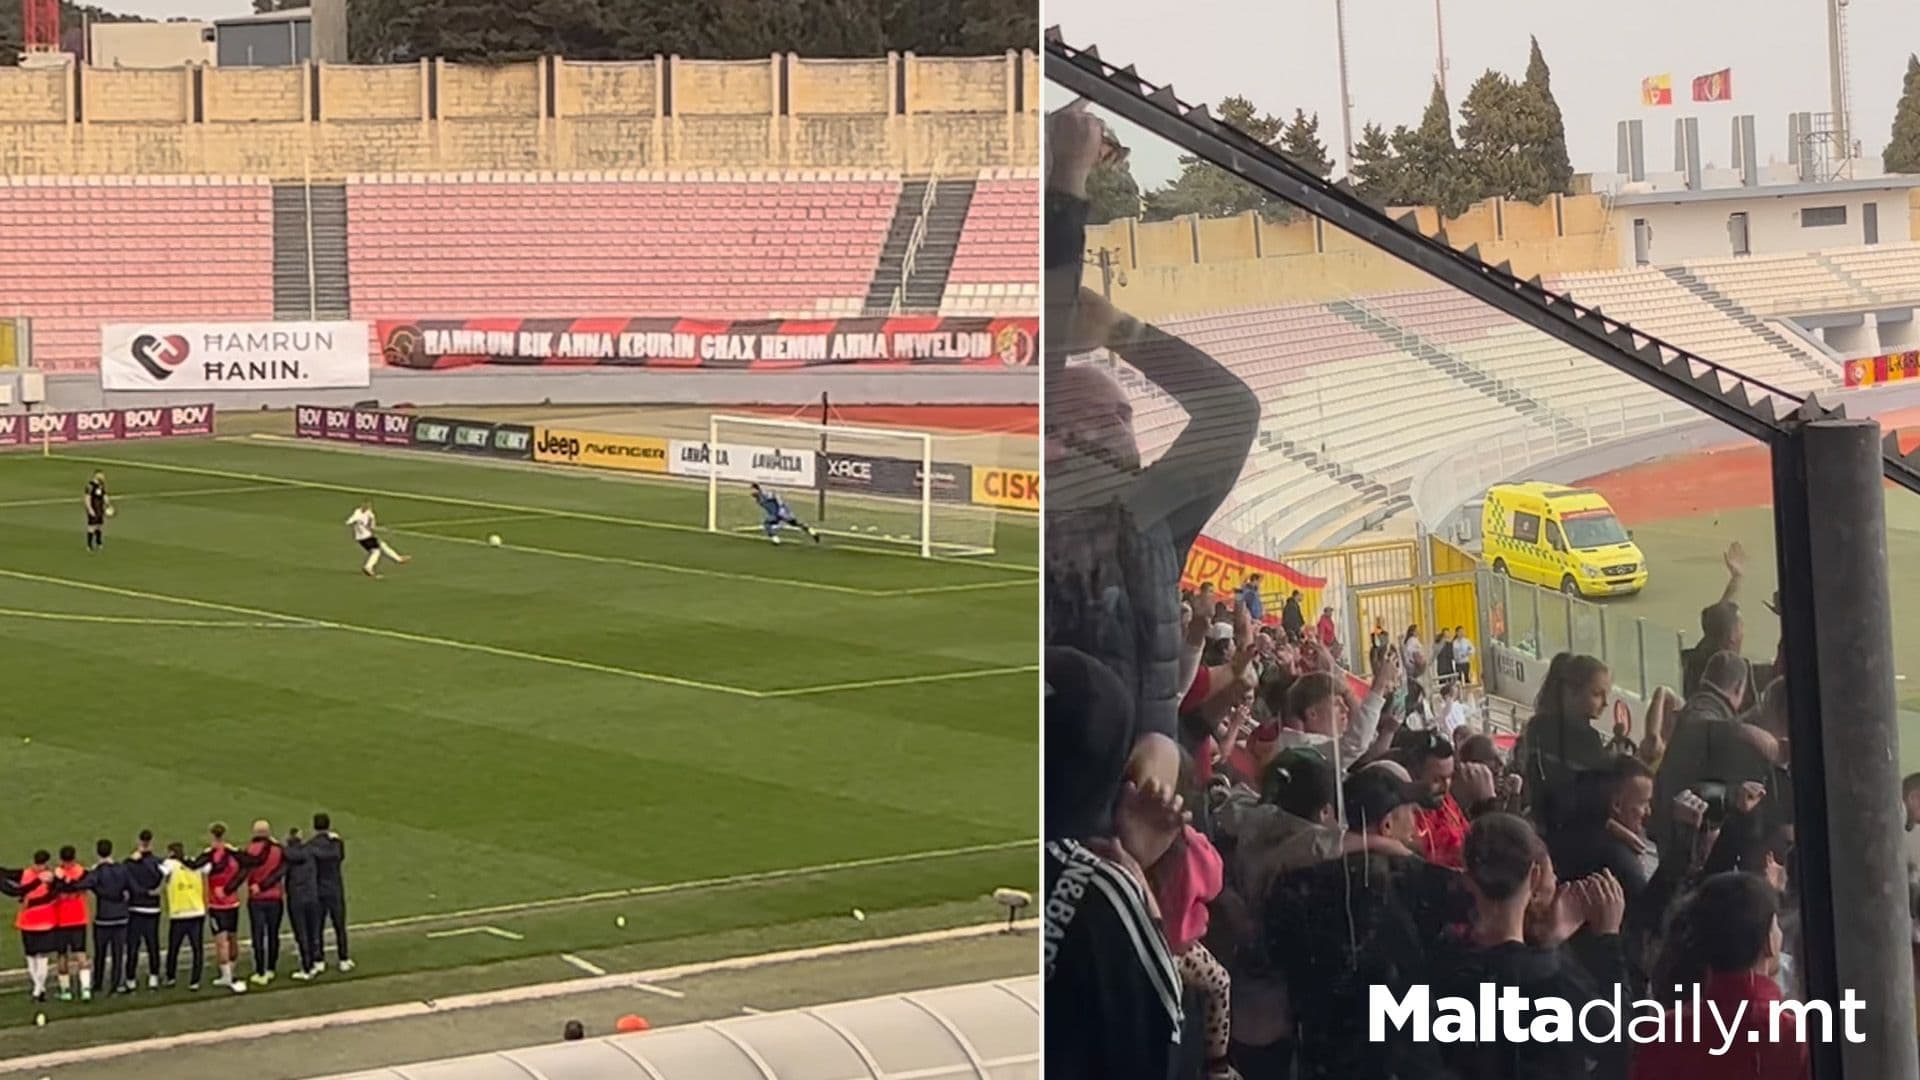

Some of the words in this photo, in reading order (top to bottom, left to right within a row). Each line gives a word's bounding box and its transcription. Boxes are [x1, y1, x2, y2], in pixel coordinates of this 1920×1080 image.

[28, 415, 68, 433] BOV
[77, 412, 115, 430] BOV
[125, 409, 162, 428] BOV
[171, 406, 209, 425] BOV
[298, 408, 322, 425] BOV
[326, 410, 350, 428] BOV
[355, 412, 379, 430] BOV
[384, 414, 409, 432] BOV
[537, 429, 580, 461] Jeep
[827, 459, 873, 480] XACE
